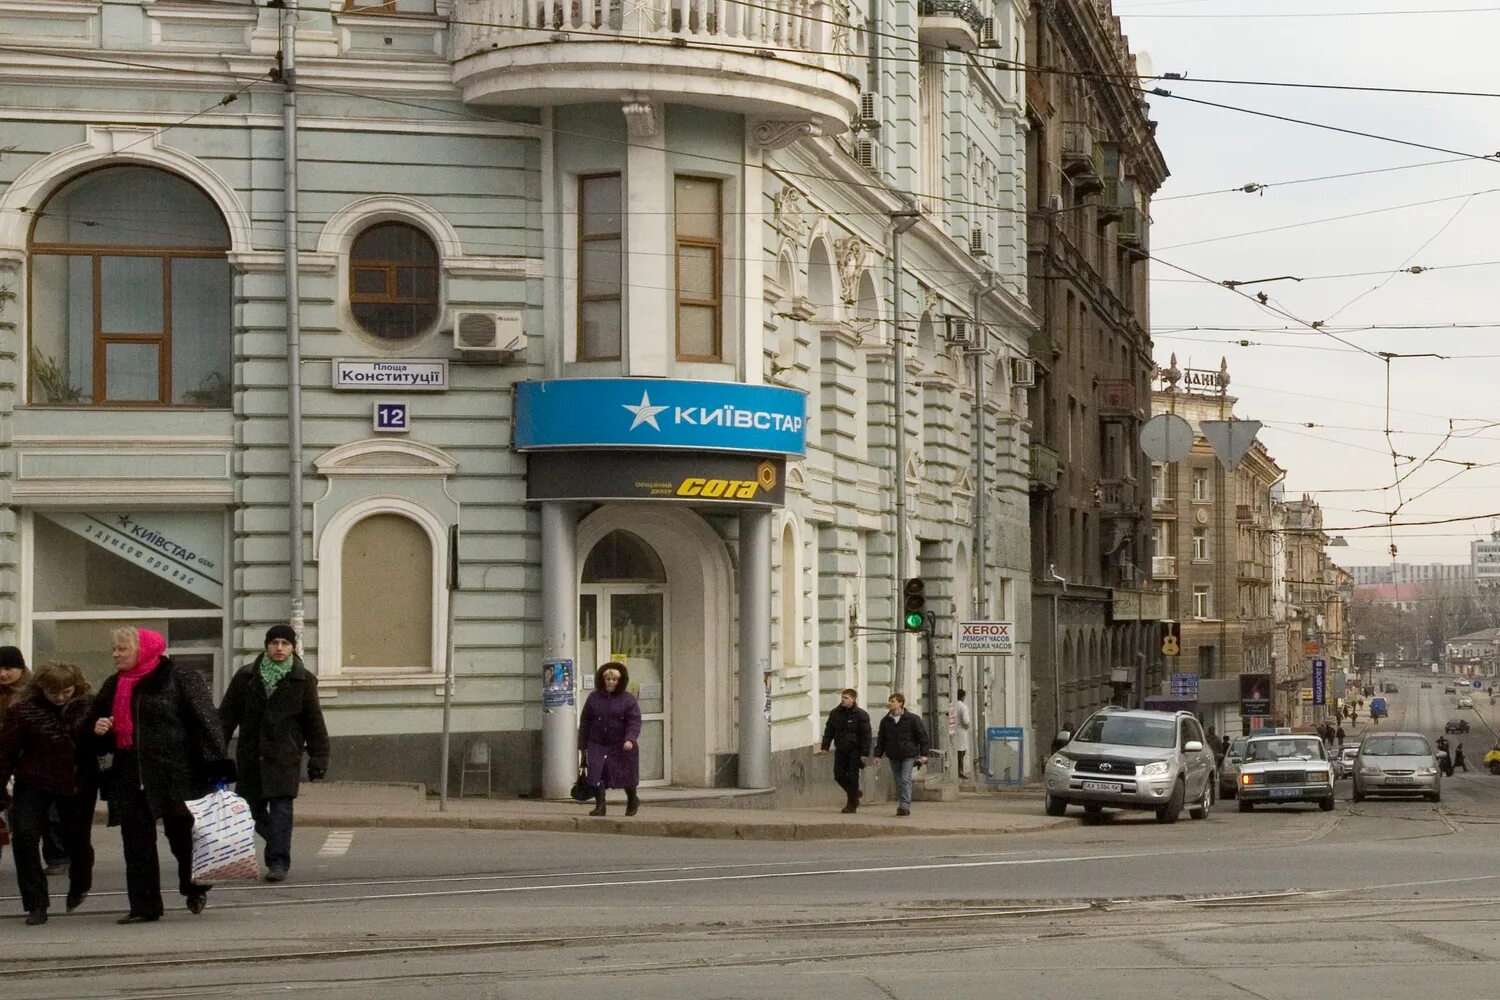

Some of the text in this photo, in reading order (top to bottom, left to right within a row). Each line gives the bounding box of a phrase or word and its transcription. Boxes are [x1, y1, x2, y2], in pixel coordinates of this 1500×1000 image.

[373, 363, 407, 372] Площа
[342, 370, 440, 384] Конституції
[380, 409, 403, 425] 12
[674, 405, 802, 433] КИЇВСТАР
[131, 525, 196, 561] КИЇВСТАР
[95, 531, 143, 558] думкою
[146, 556, 169, 572] про
[172, 570, 194, 584] вас
[963, 625, 1008, 635] XEROX
[960, 642, 1012, 650] ПРОДАЖА ЧАСОВ
